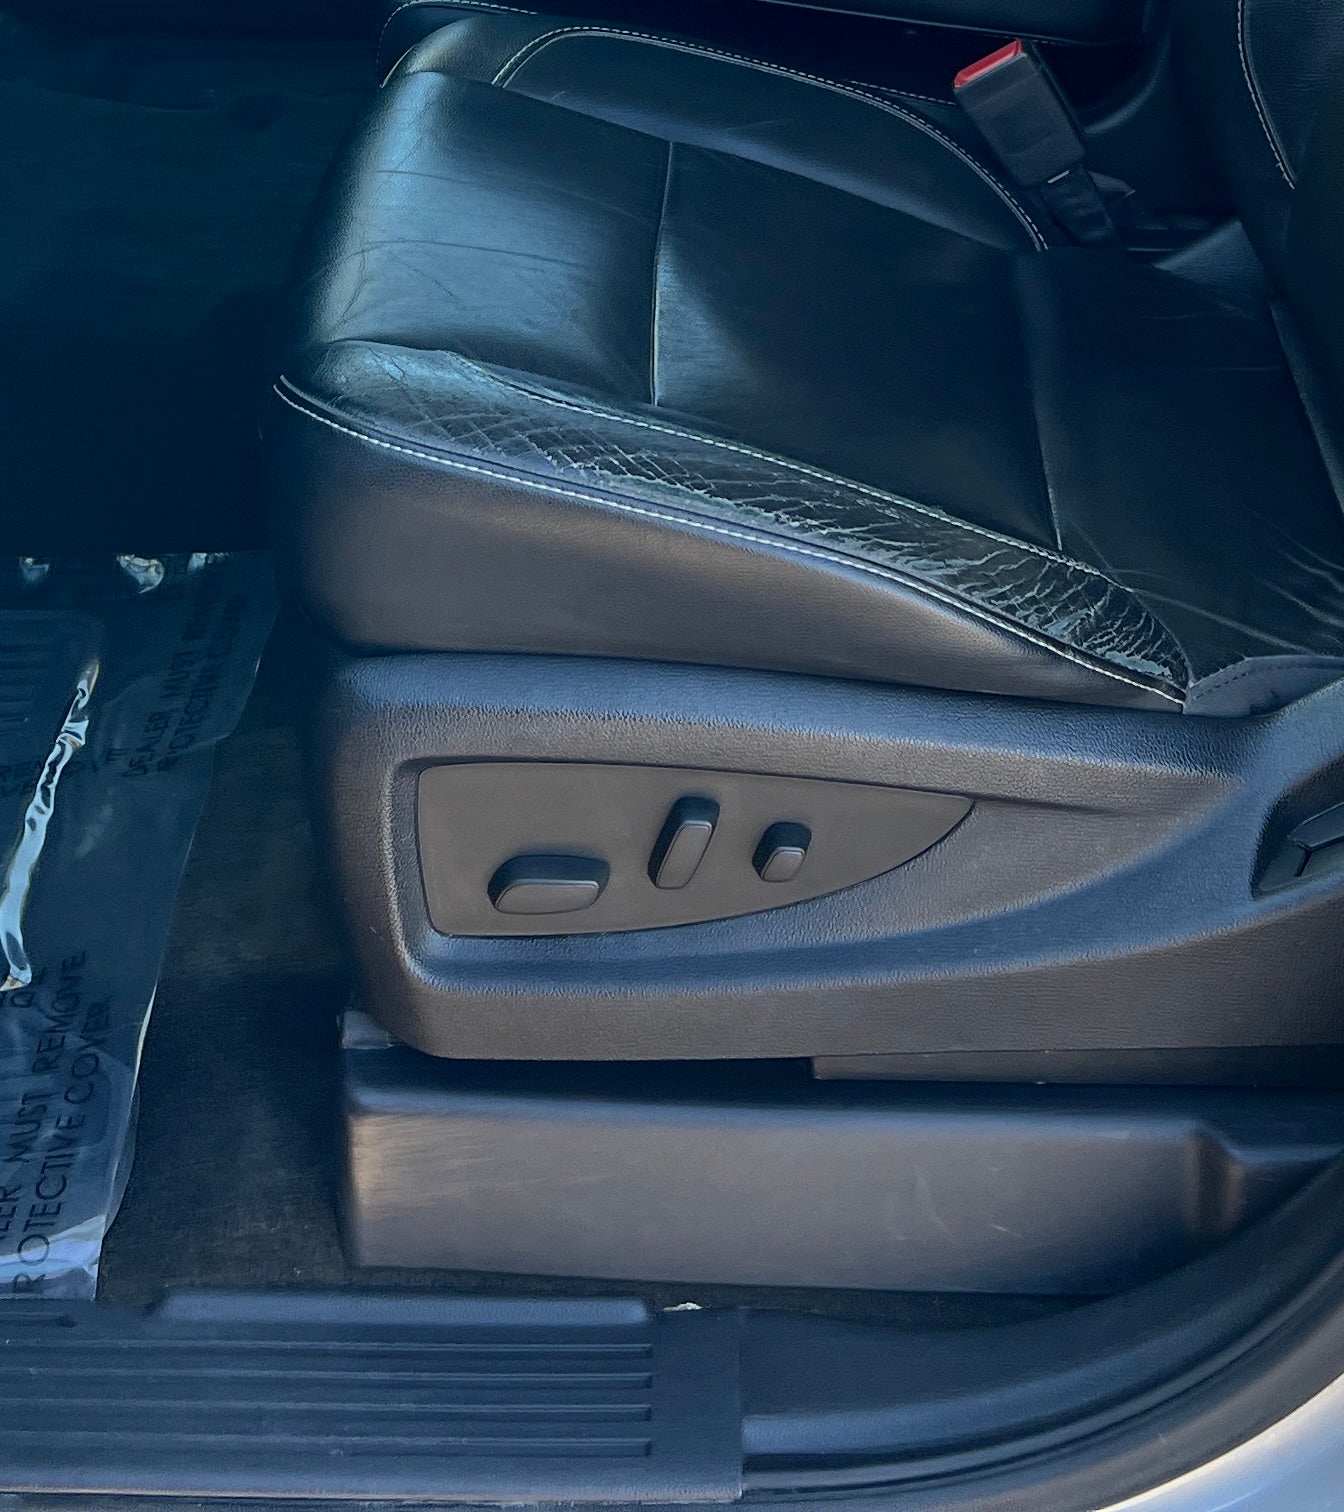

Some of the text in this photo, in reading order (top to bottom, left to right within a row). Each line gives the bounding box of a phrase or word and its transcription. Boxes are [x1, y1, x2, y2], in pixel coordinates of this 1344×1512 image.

[2, 1091, 57, 1163] MUST
[31, 950, 87, 1074] REMOVE
[13, 996, 113, 1293] ROTECTIVE COVER
